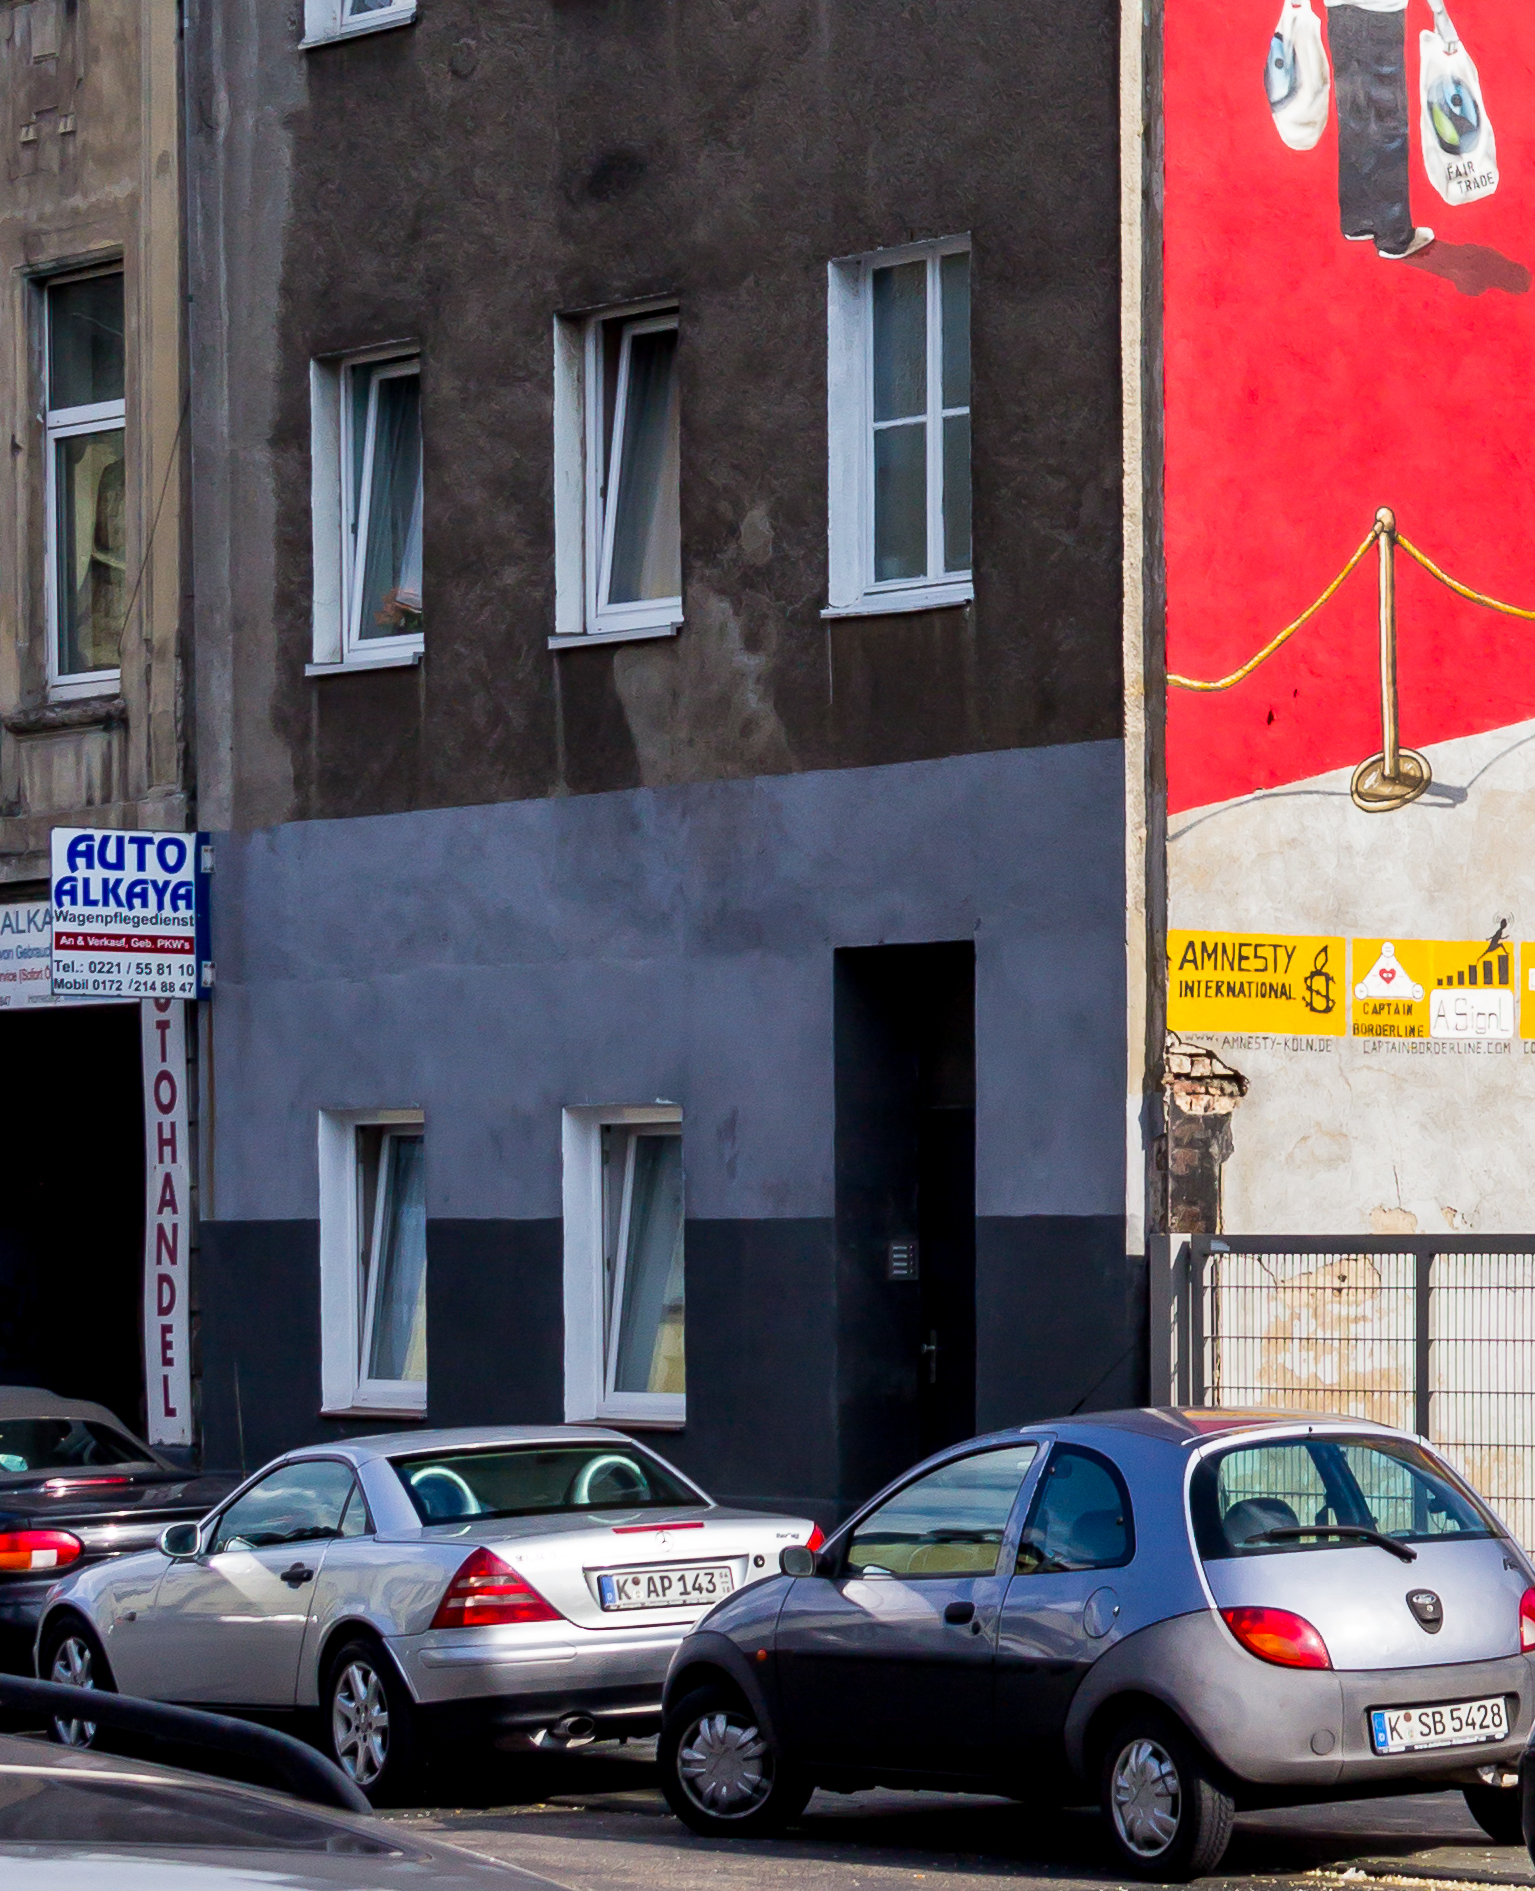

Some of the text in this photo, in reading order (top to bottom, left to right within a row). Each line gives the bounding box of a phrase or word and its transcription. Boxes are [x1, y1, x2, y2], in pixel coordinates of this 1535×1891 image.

[1447, 161, 1475, 181] FAIR
[1457, 172, 1494, 194] TRADE
[66, 833, 188, 874] AUTO
[54, 875, 194, 913] ALKAYA
[54, 909, 195, 928] Wagenpflegedienst
[60, 935, 74, 946] An
[76, 936, 85, 946] &
[130, 937, 155, 948] Geb.
[157, 938, 190, 950] PKW's
[1178, 939, 1297, 974] AMNESTY
[54, 959, 84, 974] Tel.:
[88, 960, 122, 974] 0221
[136, 962, 152, 975] 55
[156, 963, 172, 976] 81
[178, 963, 195, 977] 10
[54, 977, 89, 990] Mobil
[92, 979, 123, 991] 0172
[160, 980, 176, 993] 88
[178, 981, 194, 993] 47
[1178, 979, 1297, 1001] INTERNATIONAL
[1363, 1002, 1413, 1016] CAPTAIN
[1352, 1022, 1424, 1037] BORDERLINE
[1363, 1039, 1512, 1055] CAPTAINBORDERLINE.COM
[616, 1577, 632, 1601] K
[646, 1577, 674, 1598] AP
[679, 1572, 717, 1596] 143
[1388, 1715, 1404, 1742] K
[1418, 1710, 1447, 1738] SB
[1449, 1703, 1504, 1733] 5428
